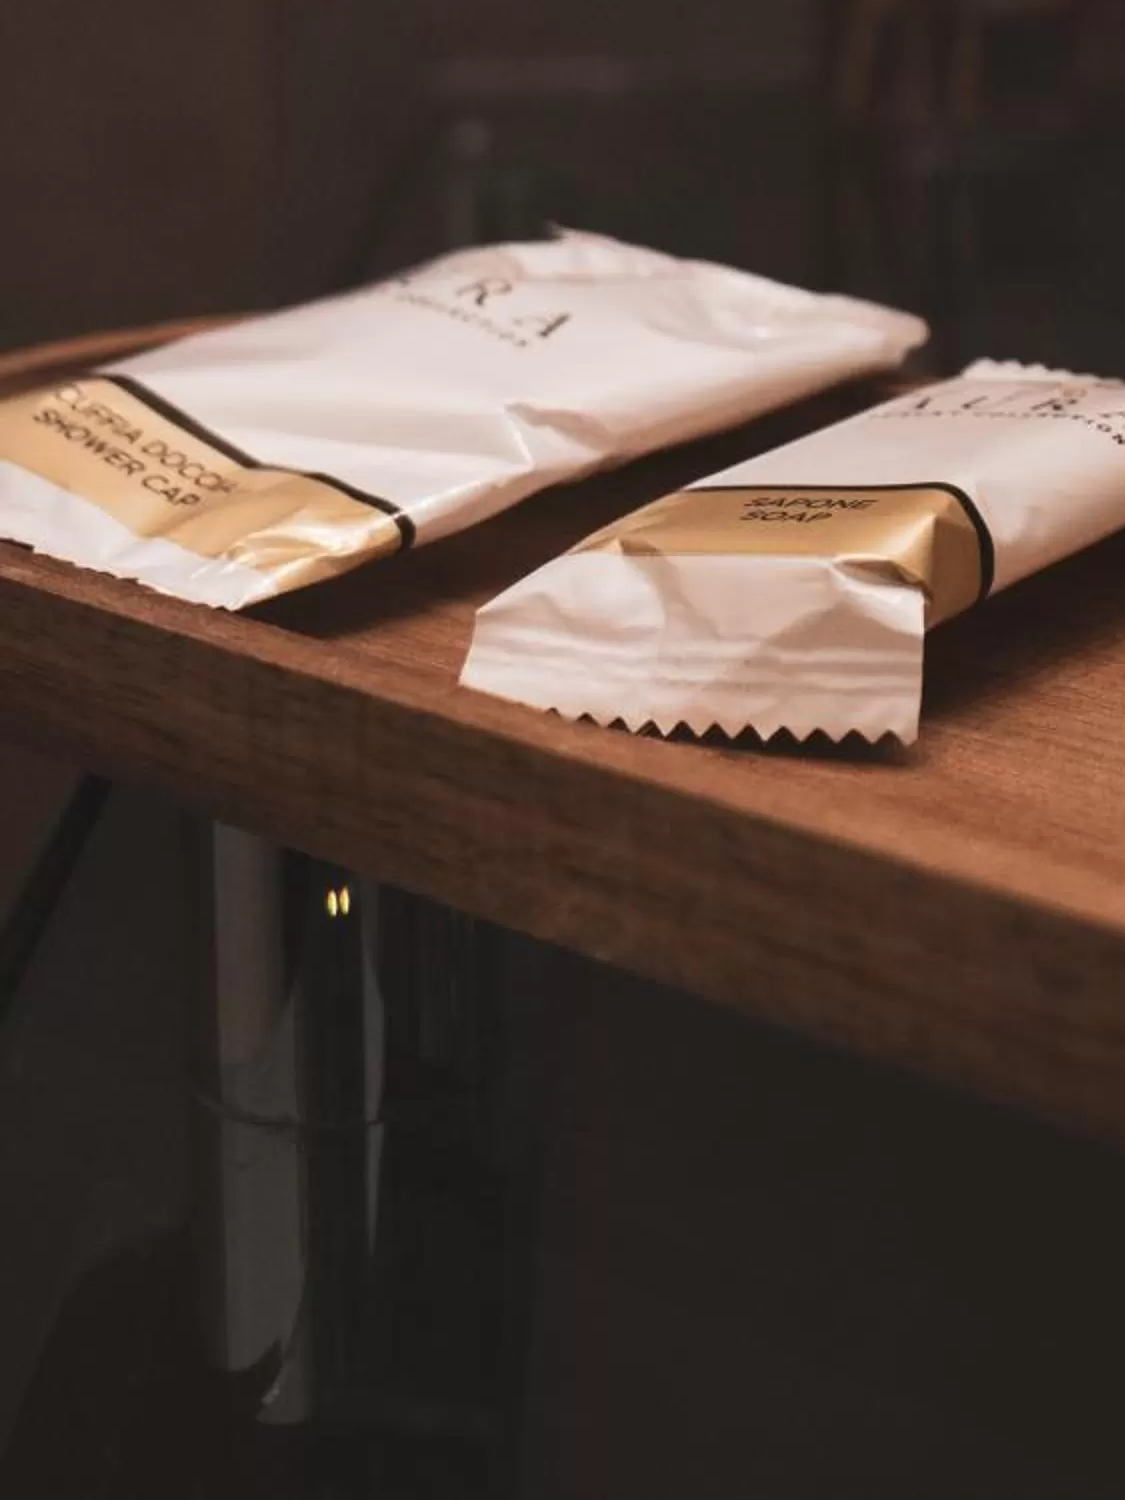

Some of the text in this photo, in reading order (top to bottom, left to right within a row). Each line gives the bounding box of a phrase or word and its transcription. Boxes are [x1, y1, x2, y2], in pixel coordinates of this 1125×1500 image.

[32, 407, 202, 506] SHOWER CAP
[743, 496, 879, 511] SAPONE
[739, 510, 834, 524] SOAP
